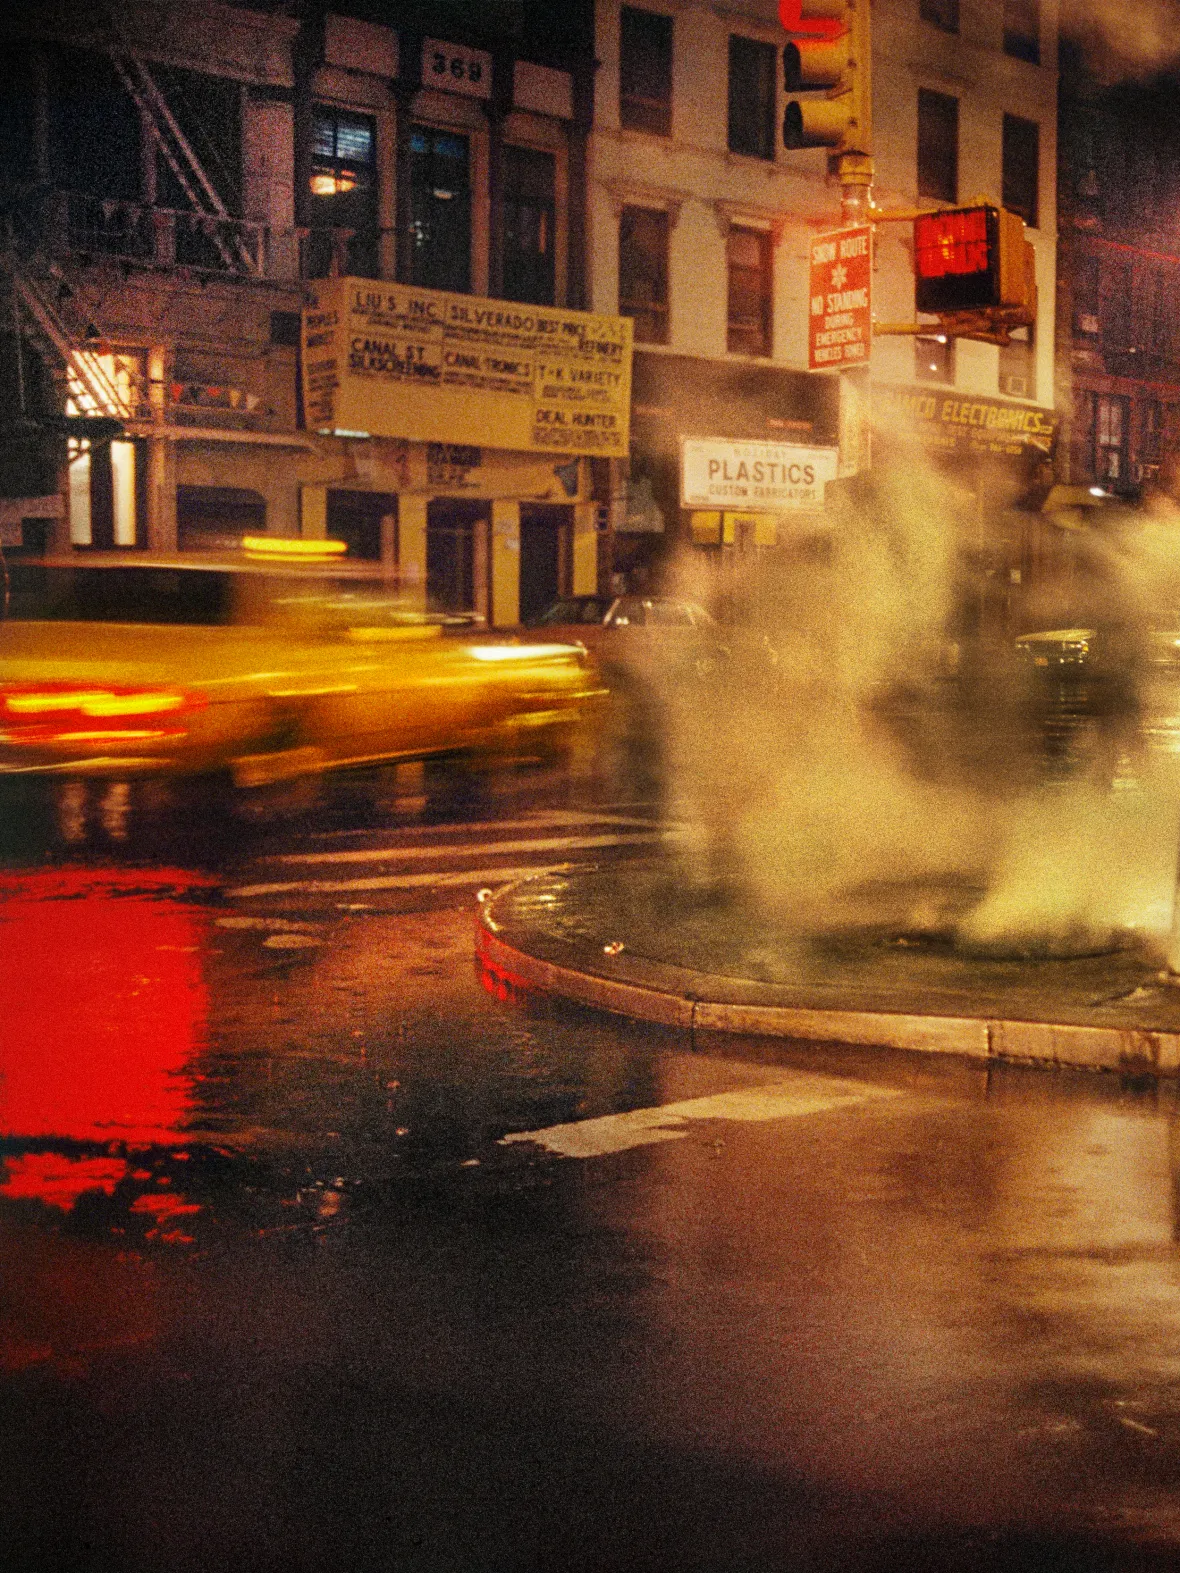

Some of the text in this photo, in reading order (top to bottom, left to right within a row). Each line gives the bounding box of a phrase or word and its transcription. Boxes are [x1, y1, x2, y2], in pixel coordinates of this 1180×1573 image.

[432, 53, 482, 82] 369
[839, 235, 868, 259] ROUTE
[811, 287, 868, 316] NO STANDING
[450, 304, 535, 332] SILVERADO
[351, 337, 397, 355] CANAL
[941, 400, 1045, 433] ELECTRONICS
[708, 458, 815, 485] PLASTICS
[708, 484, 748, 497] CUSTOM
[754, 487, 816, 500] FABRICATORS
